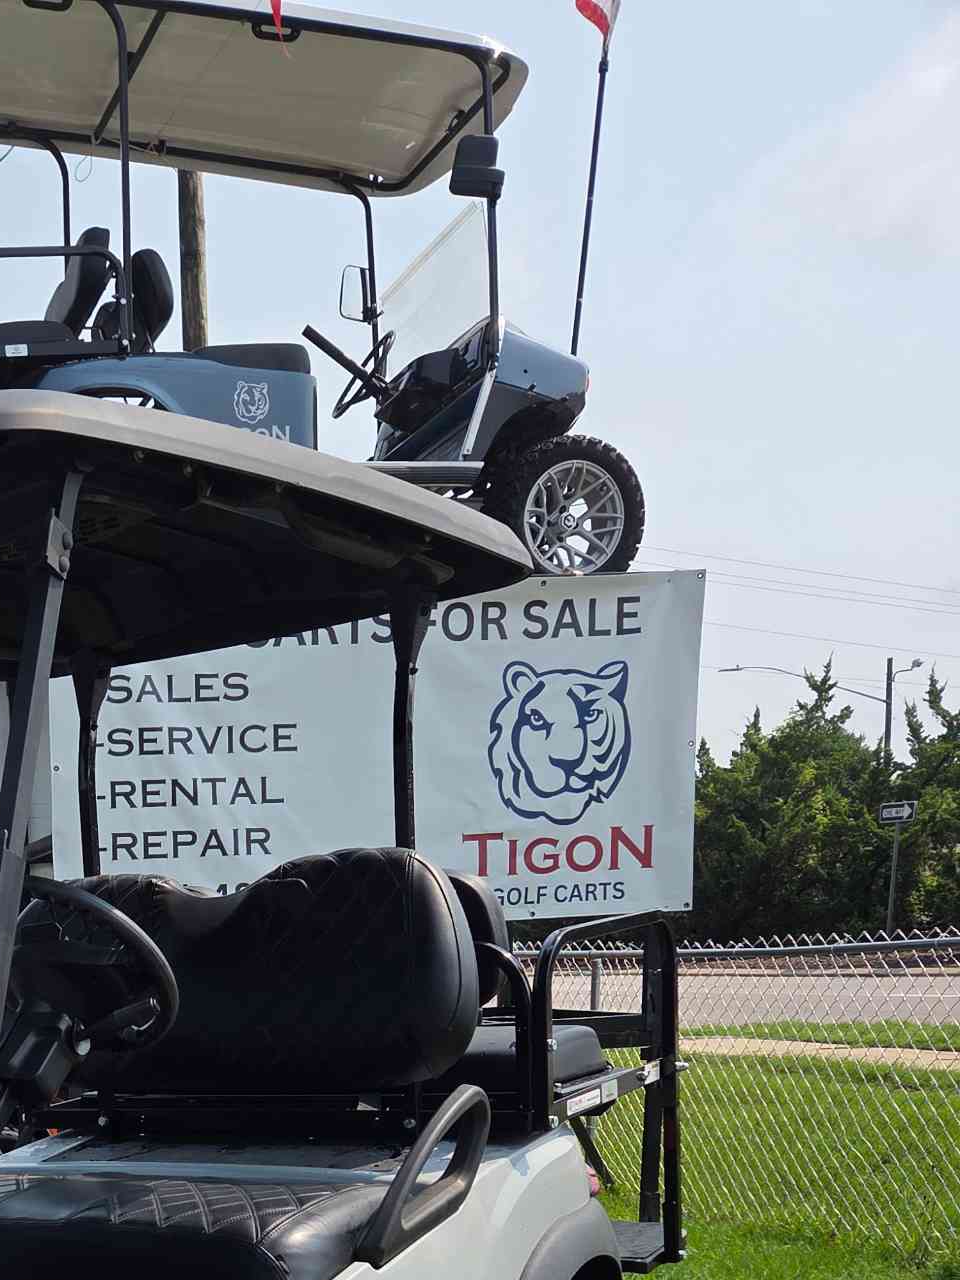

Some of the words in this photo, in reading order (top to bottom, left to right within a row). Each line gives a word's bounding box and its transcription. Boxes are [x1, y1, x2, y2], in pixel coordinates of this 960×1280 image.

[522, 596, 642, 640] SALE
[106, 672, 250, 704] SALES
[462, 824, 655, 877] TIGON
[554, 880, 626, 902] CARTS
